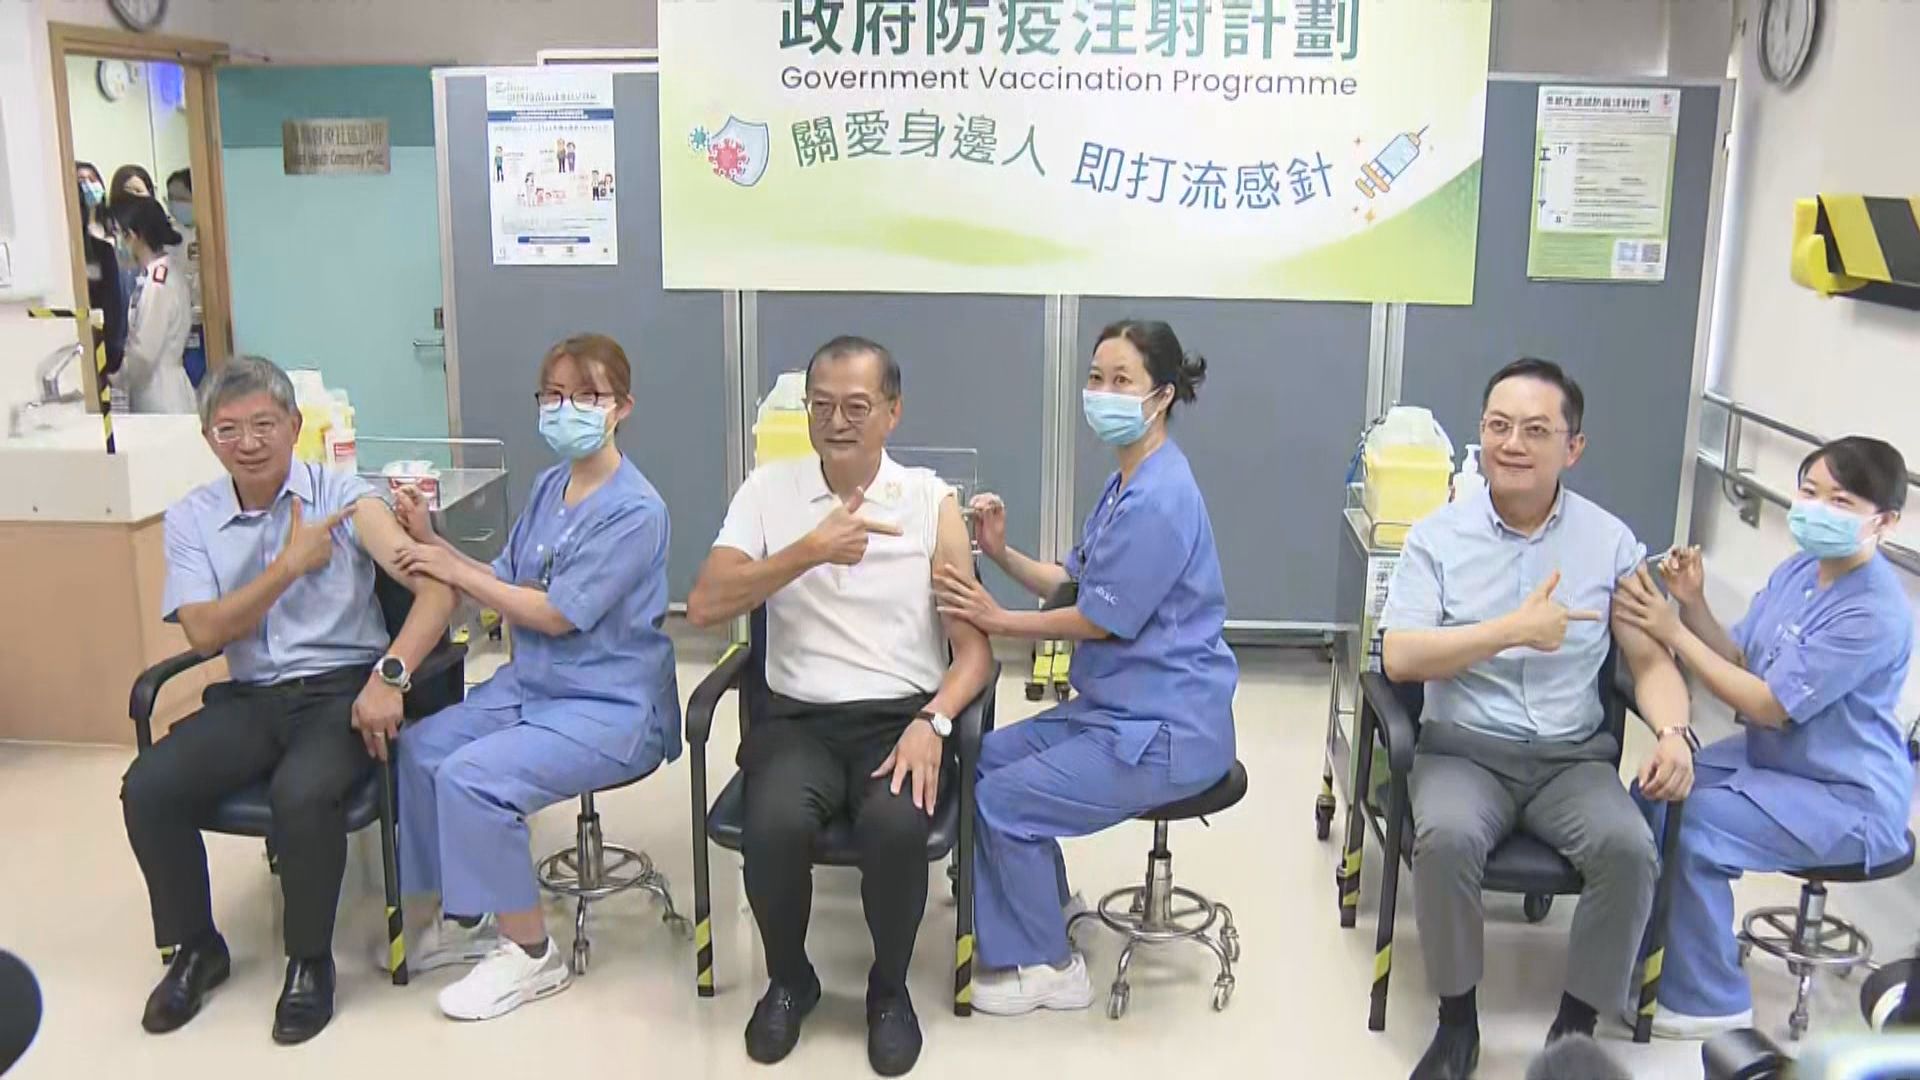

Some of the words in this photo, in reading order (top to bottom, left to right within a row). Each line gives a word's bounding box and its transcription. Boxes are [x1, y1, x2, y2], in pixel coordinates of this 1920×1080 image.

[779, 0, 1360, 61] 政府防疫注射計劃
[780, 66, 970, 90] Government
[978, 66, 1162, 92] Vaccination
[1173, 69, 1358, 101] Programme
[790, 108, 1046, 177] 關愛身邊人
[1071, 141, 1334, 210] 即打流感針
